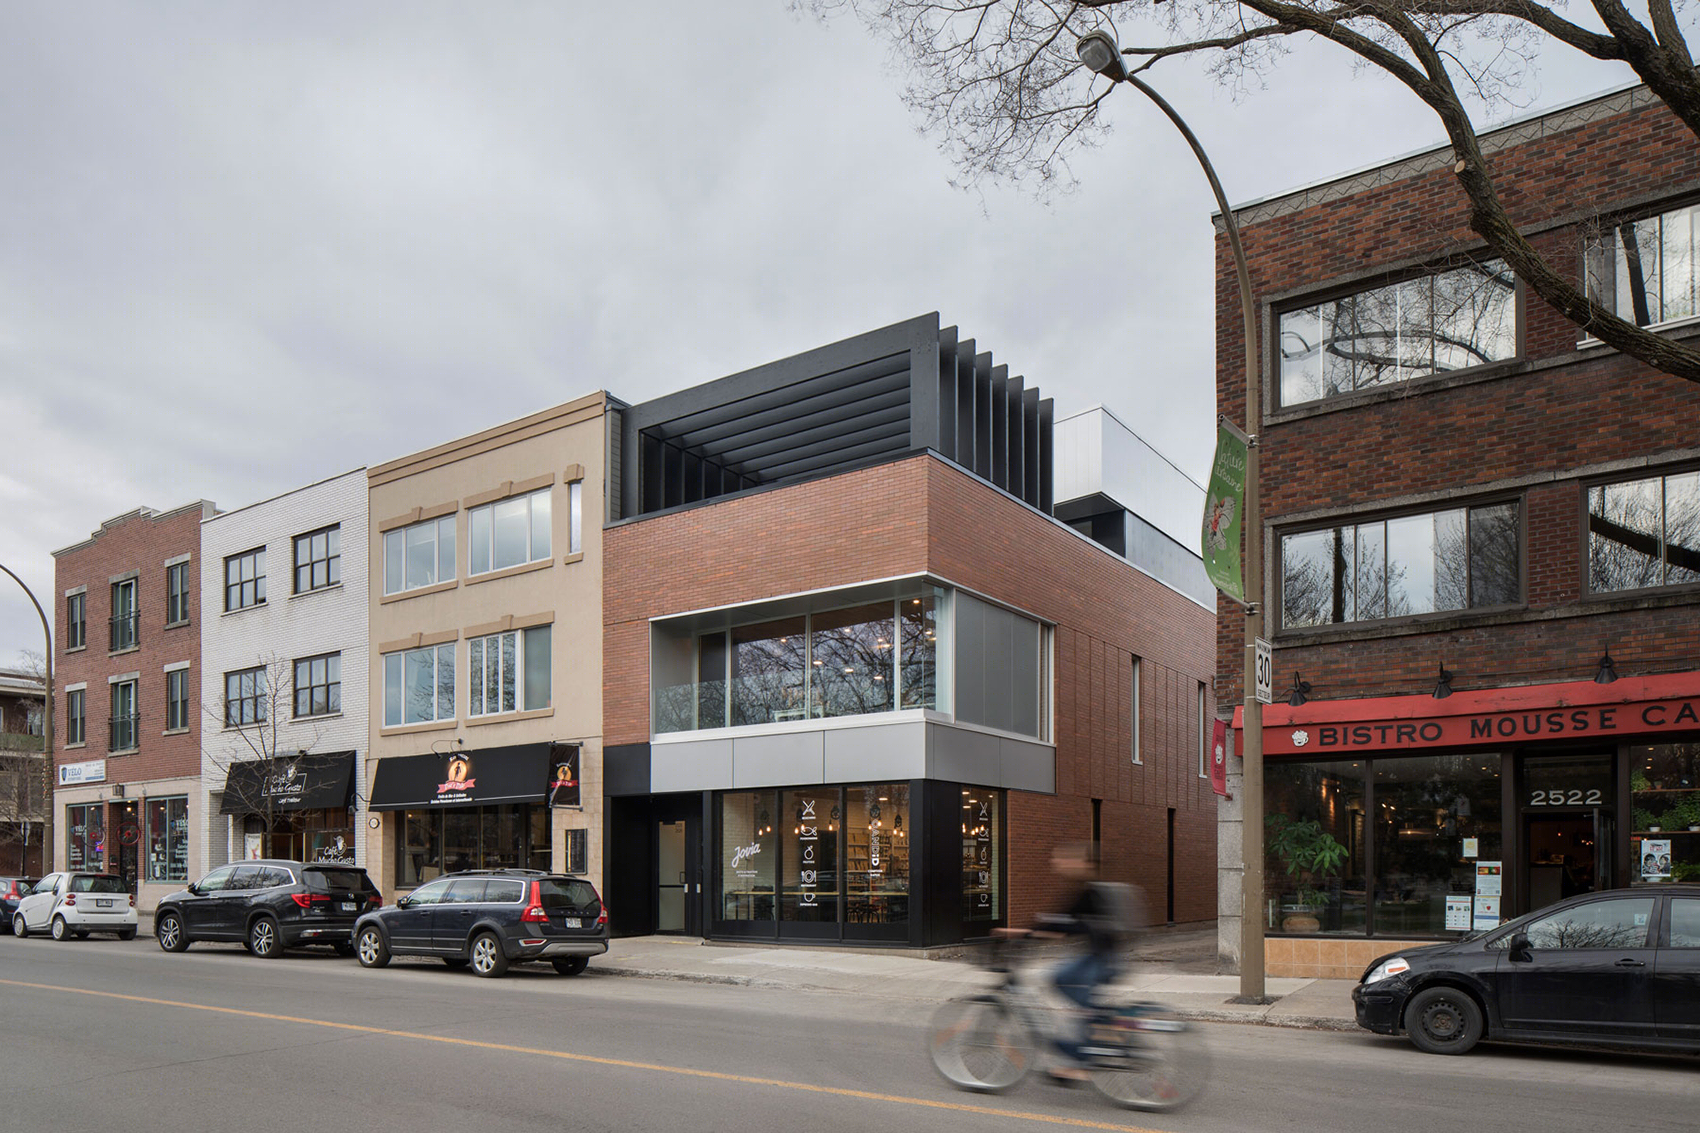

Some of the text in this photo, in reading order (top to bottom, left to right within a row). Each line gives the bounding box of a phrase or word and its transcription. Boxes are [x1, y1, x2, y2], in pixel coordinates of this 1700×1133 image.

[1257, 653, 1270, 688] 30
[1318, 722, 1443, 747] BISTRO
[1470, 708, 1618, 740] MOUSSE
[1530, 789, 1602, 807] 2522
[323, 845, 338, 859] Café
[731, 841, 761, 868] Jovia
